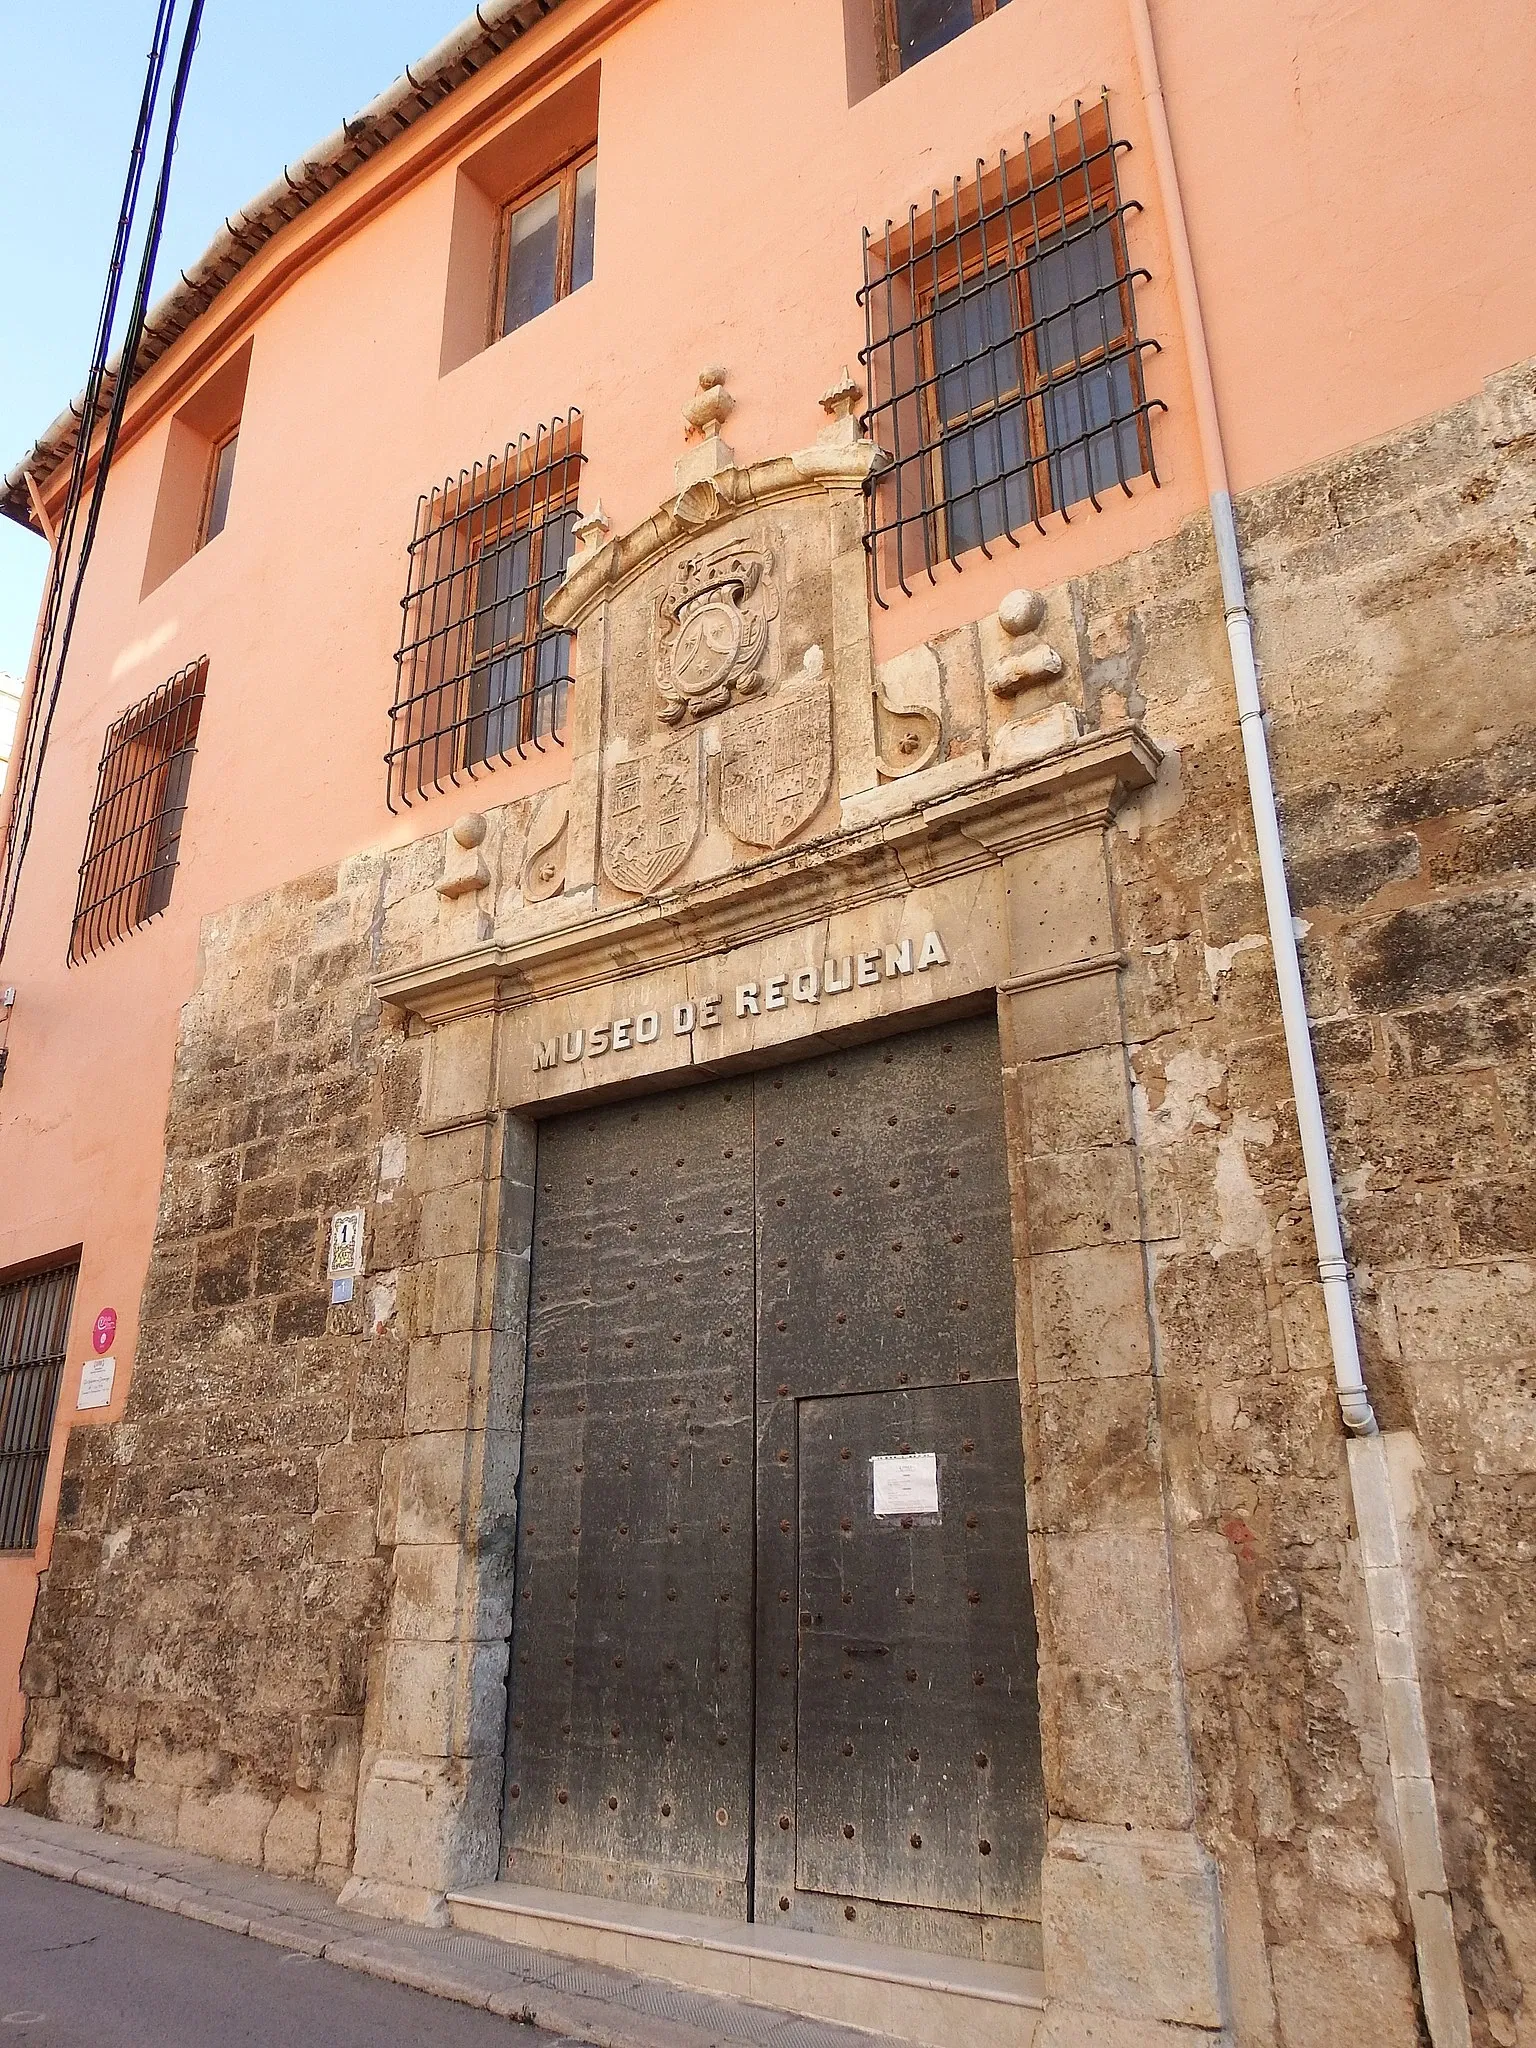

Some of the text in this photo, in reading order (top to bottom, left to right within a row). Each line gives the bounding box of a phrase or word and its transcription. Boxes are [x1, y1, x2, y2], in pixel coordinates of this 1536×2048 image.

[532, 931, 951, 1072] MUSEO DE REQUENA
[341, 1224, 348, 1243] 1
